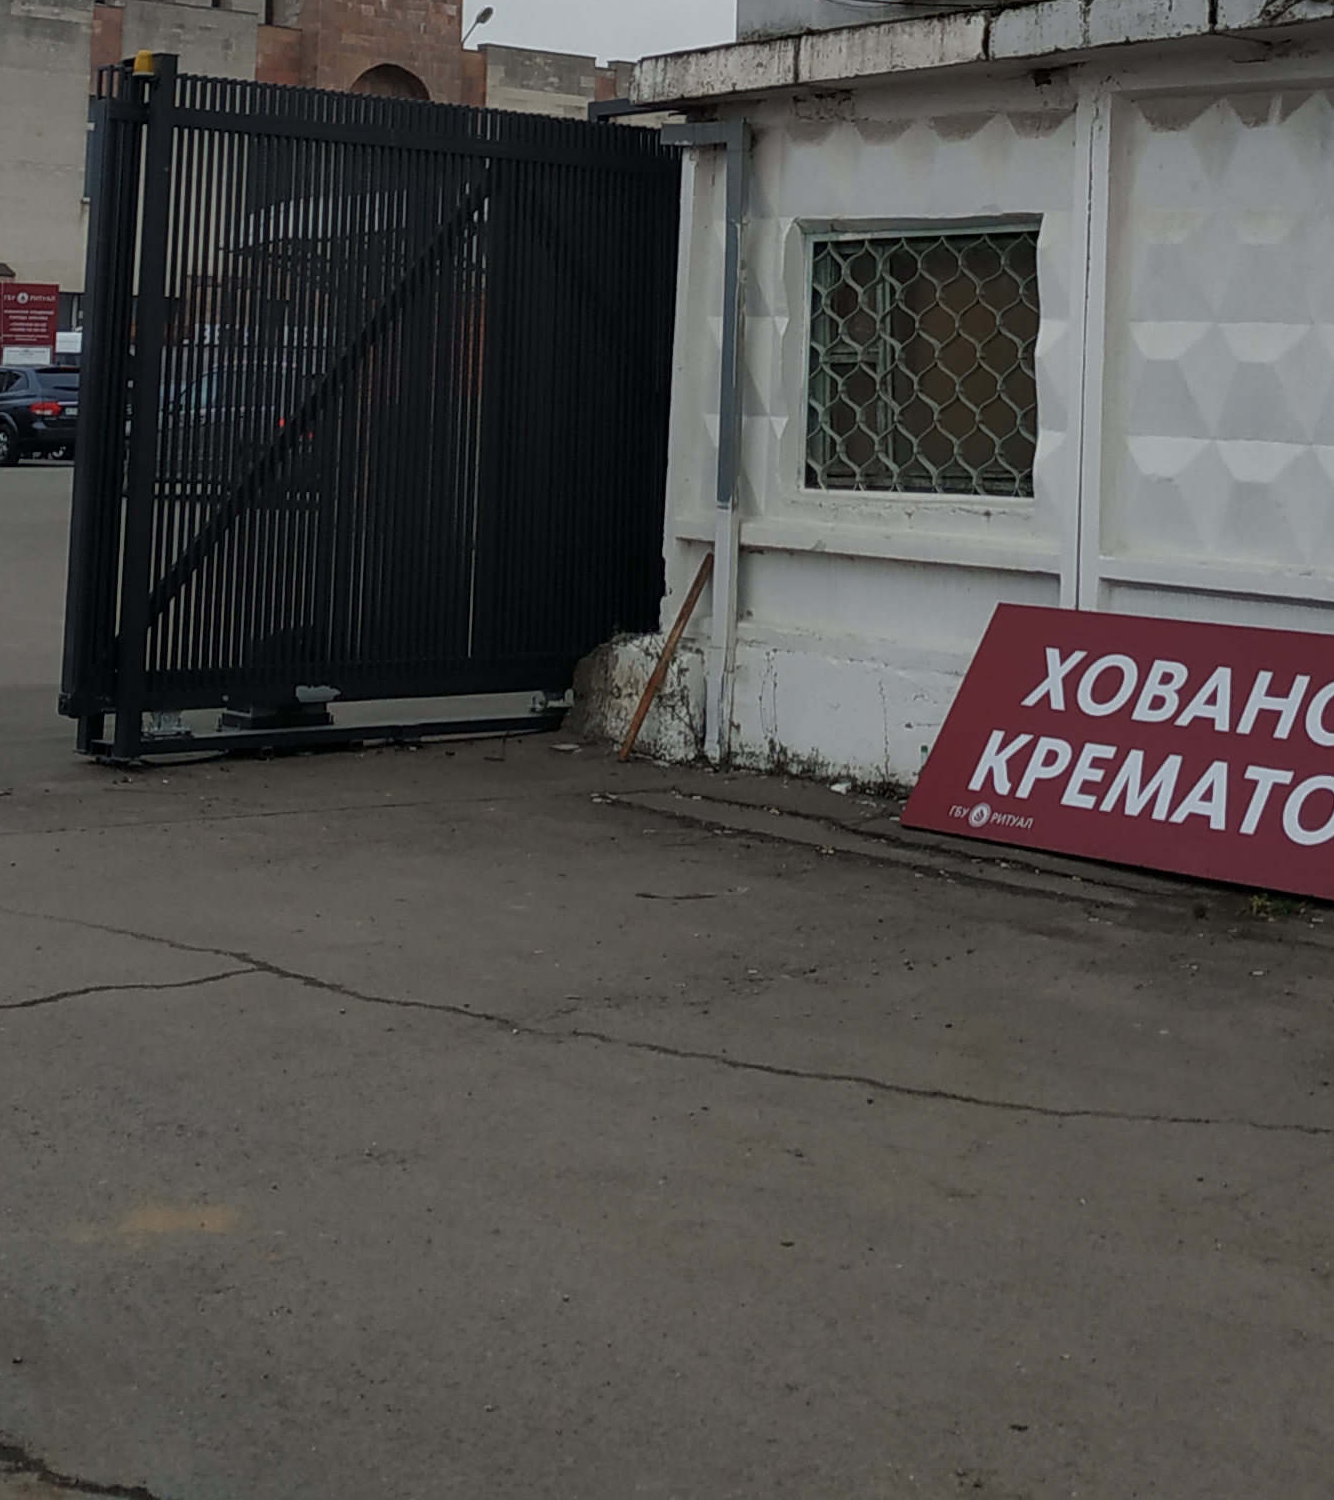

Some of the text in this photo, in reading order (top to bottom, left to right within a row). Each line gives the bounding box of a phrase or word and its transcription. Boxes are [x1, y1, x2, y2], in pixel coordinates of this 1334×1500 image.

[30, 294, 56, 302] РИТУАЛ
[948, 804, 1034, 830] ГБУ РИТУАЛ
